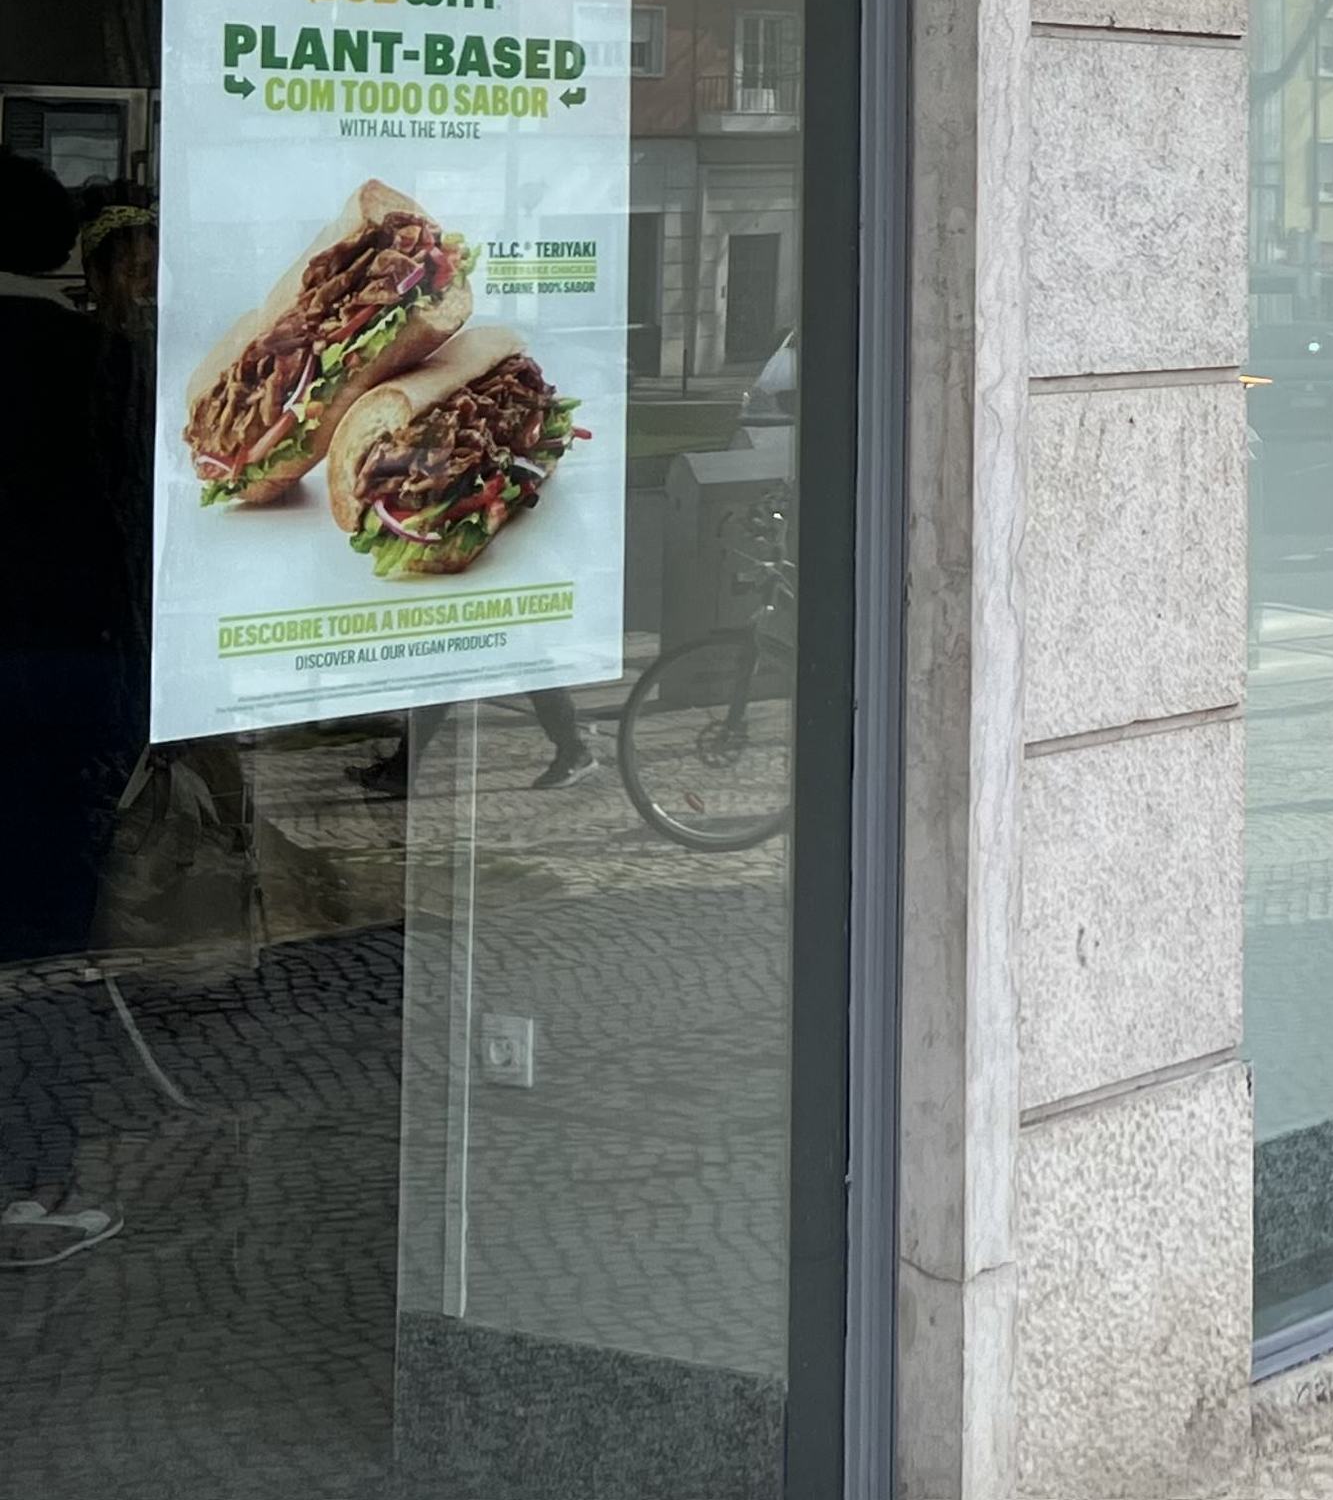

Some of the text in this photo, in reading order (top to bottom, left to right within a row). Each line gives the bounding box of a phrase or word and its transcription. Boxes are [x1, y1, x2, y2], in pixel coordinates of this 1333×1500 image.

[224, 23, 586, 80] PLANT-BASED
[264, 77, 548, 118] COM TODO O SABOR
[340, 119, 480, 139] WITH ALL THE TASTE
[535, 241, 596, 257] TERIYAKI
[502, 282, 534, 294] CARNE
[564, 281, 596, 293] SABOR
[218, 591, 574, 650] DESCOBRE TODA A NOSSA GAMA VEGAN
[295, 632, 507, 671] DISCOVER ALL OUR VEGAN PRODUCTS
